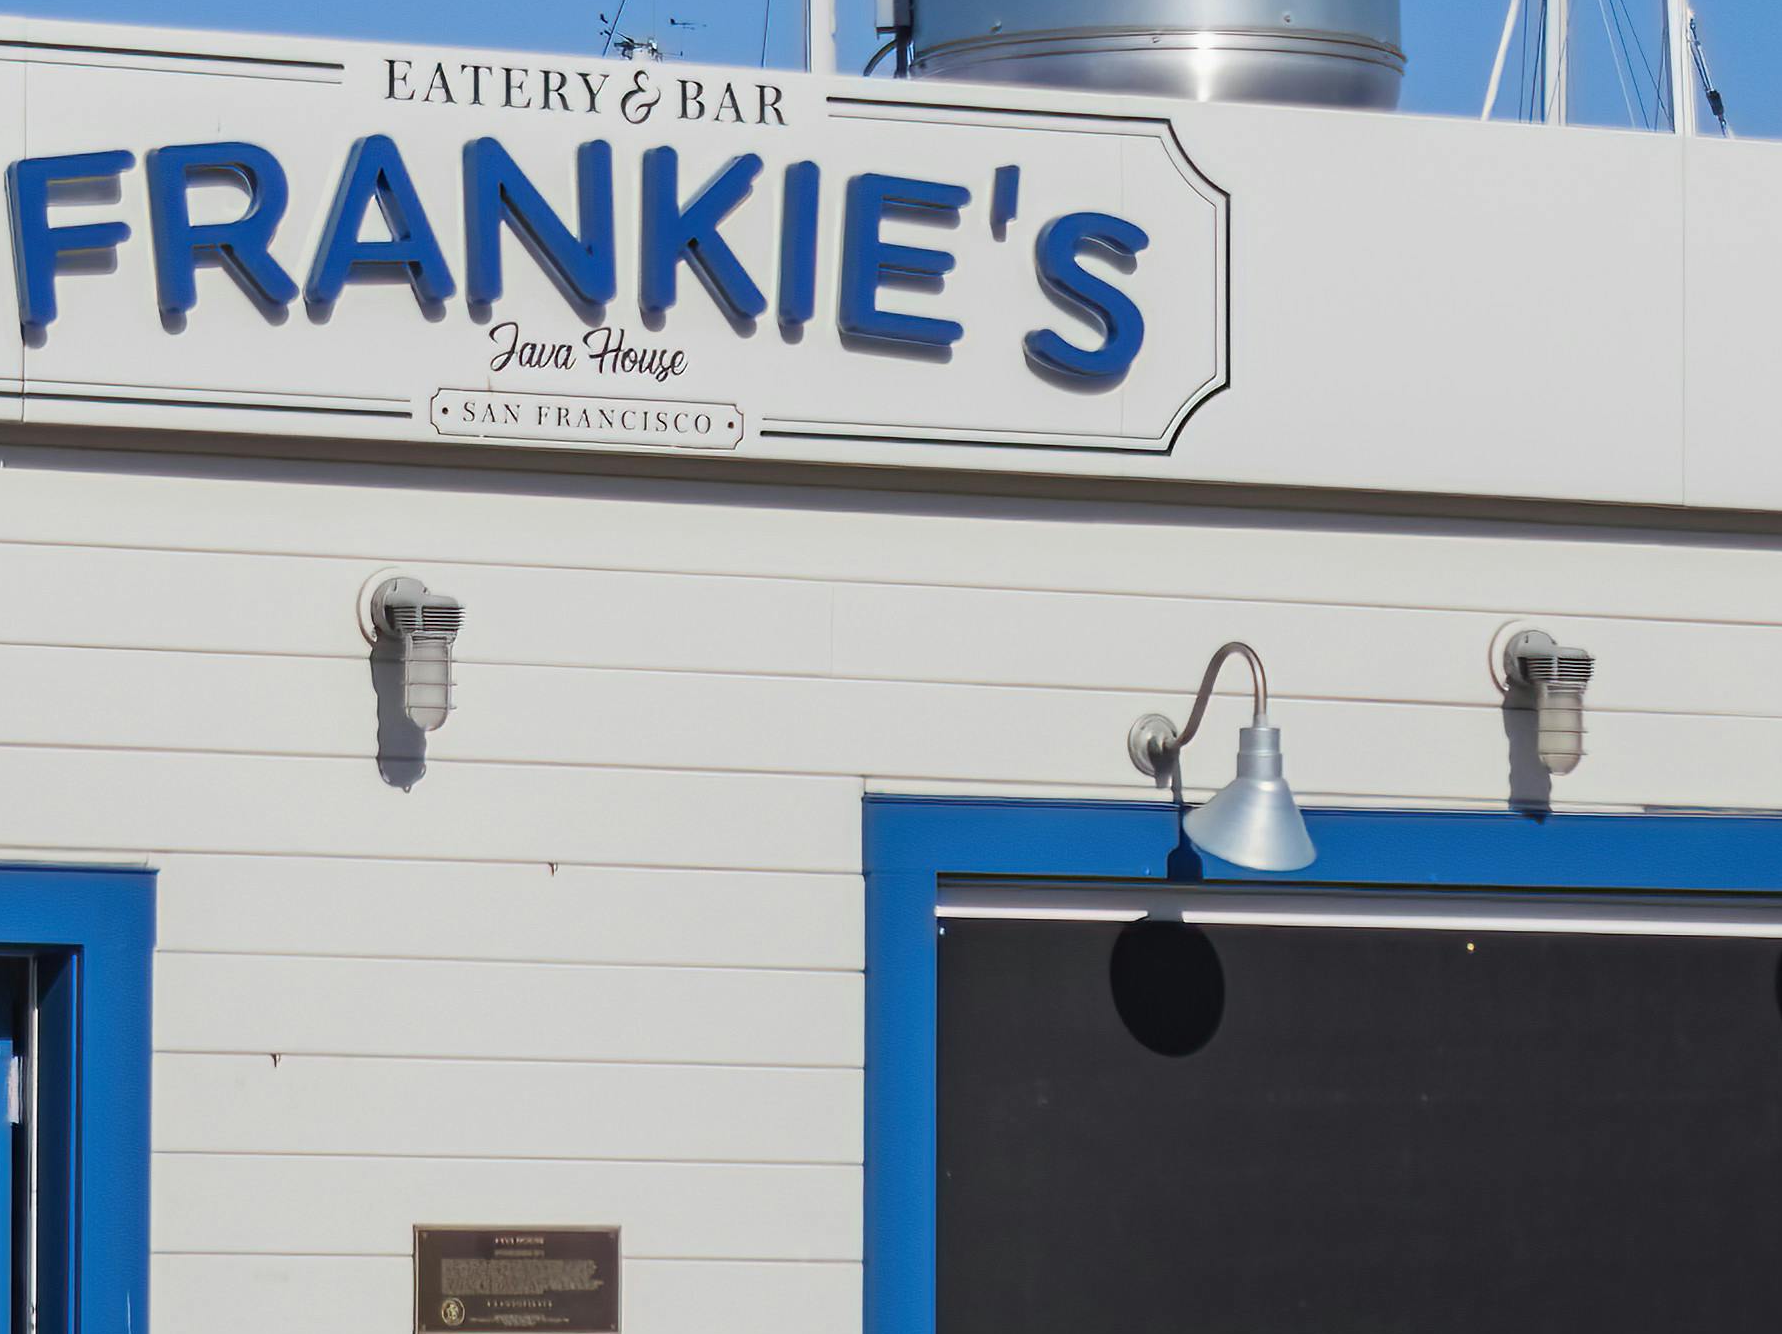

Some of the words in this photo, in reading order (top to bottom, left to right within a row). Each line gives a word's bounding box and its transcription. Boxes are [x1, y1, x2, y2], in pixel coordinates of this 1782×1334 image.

[383, 58, 611, 114] EATERY
[619, 69, 662, 125] &
[676, 78, 790, 127] BAR
[7, 132, 1151, 379] FRANKIE'S
[488, 321, 578, 372] Java
[582, 326, 690, 383] House
[461, 400, 521, 425] SAN
[537, 404, 712, 435] FRANCISCO
